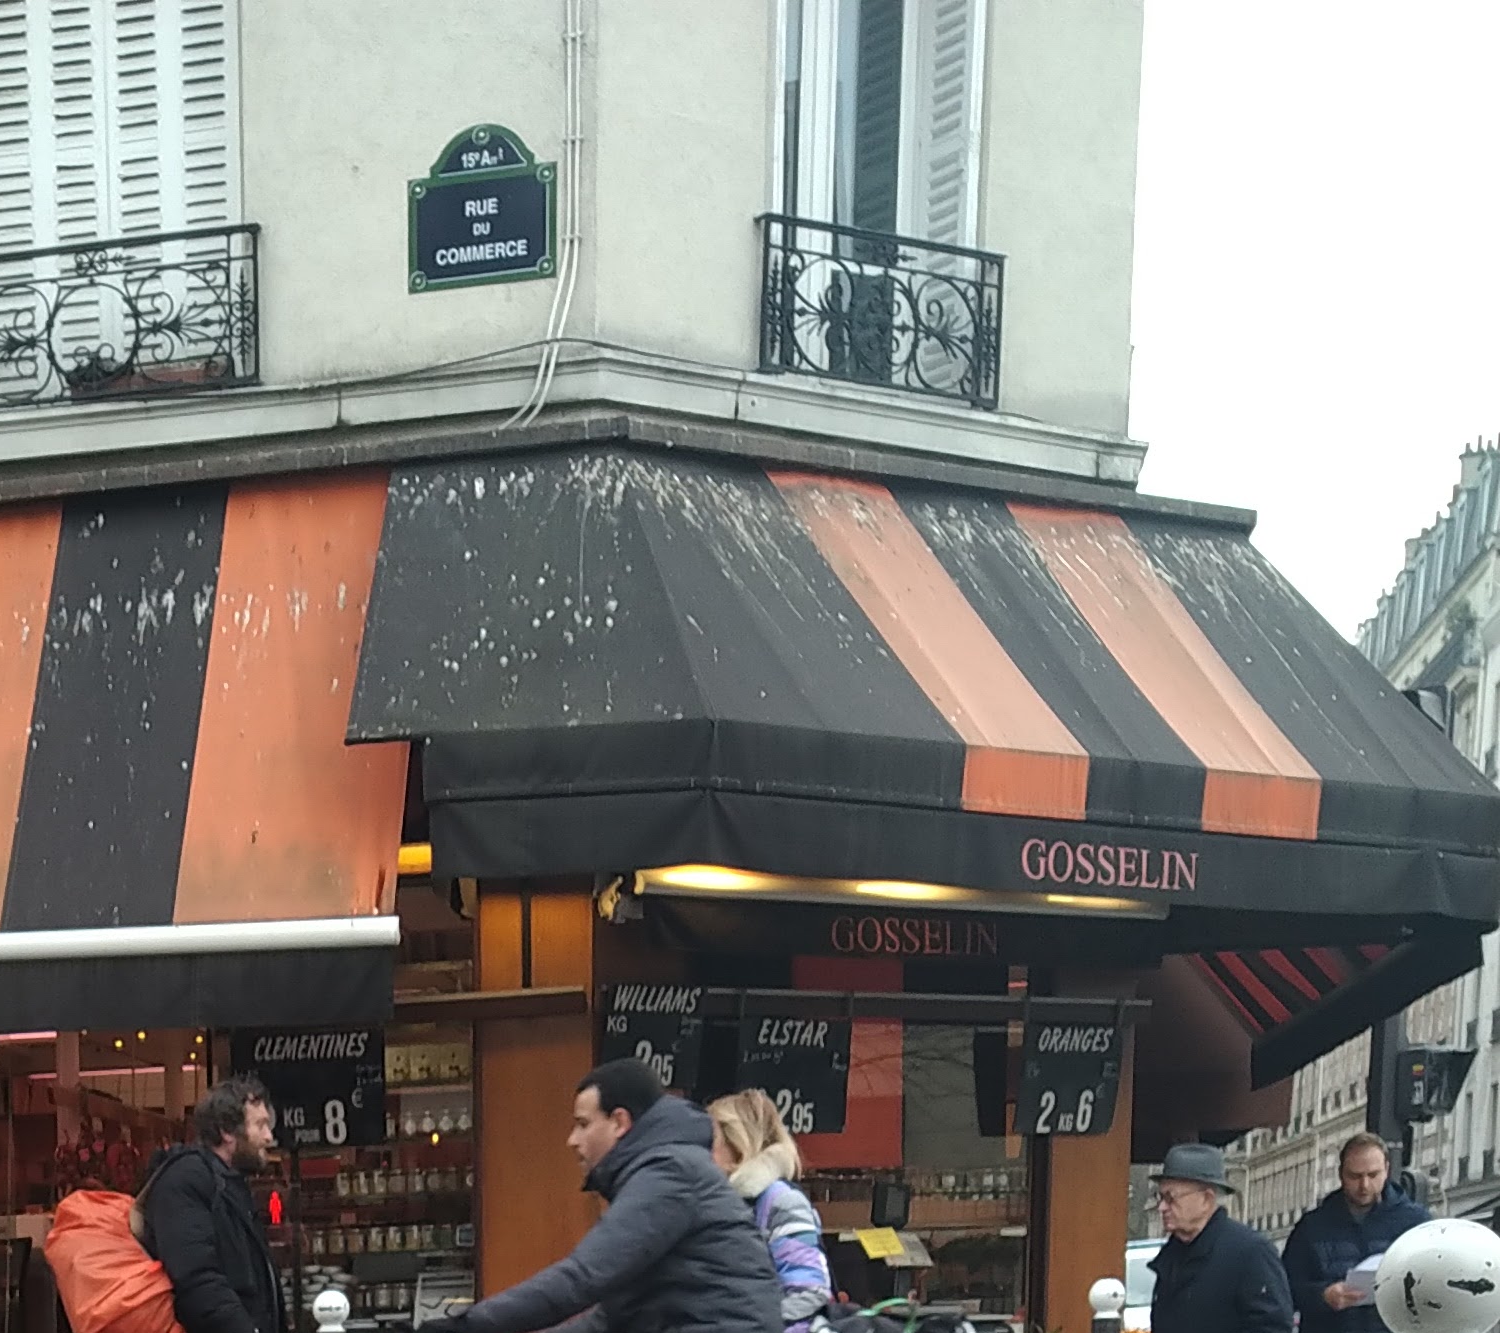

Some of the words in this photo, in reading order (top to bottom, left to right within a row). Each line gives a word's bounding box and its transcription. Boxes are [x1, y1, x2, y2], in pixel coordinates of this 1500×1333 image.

[465, 198, 499, 217] RUE
[472, 221, 491, 236] DU
[436, 239, 528, 266] COMMERCE
[1020, 837, 1200, 892] GOSSELIN
[830, 915, 999, 956] GOSSELIN
[612, 984, 702, 1015] WILLIAMS
[606, 1014, 629, 1034] KG
[757, 1018, 829, 1050] ELSTAR
[254, 1033, 368, 1061] CLEMENTINES
[1038, 1026, 1115, 1054] ORANGES
[283, 1106, 305, 1128] KG
[1035, 1090, 1056, 1135] 2
[1057, 1112, 1074, 1132] KG
